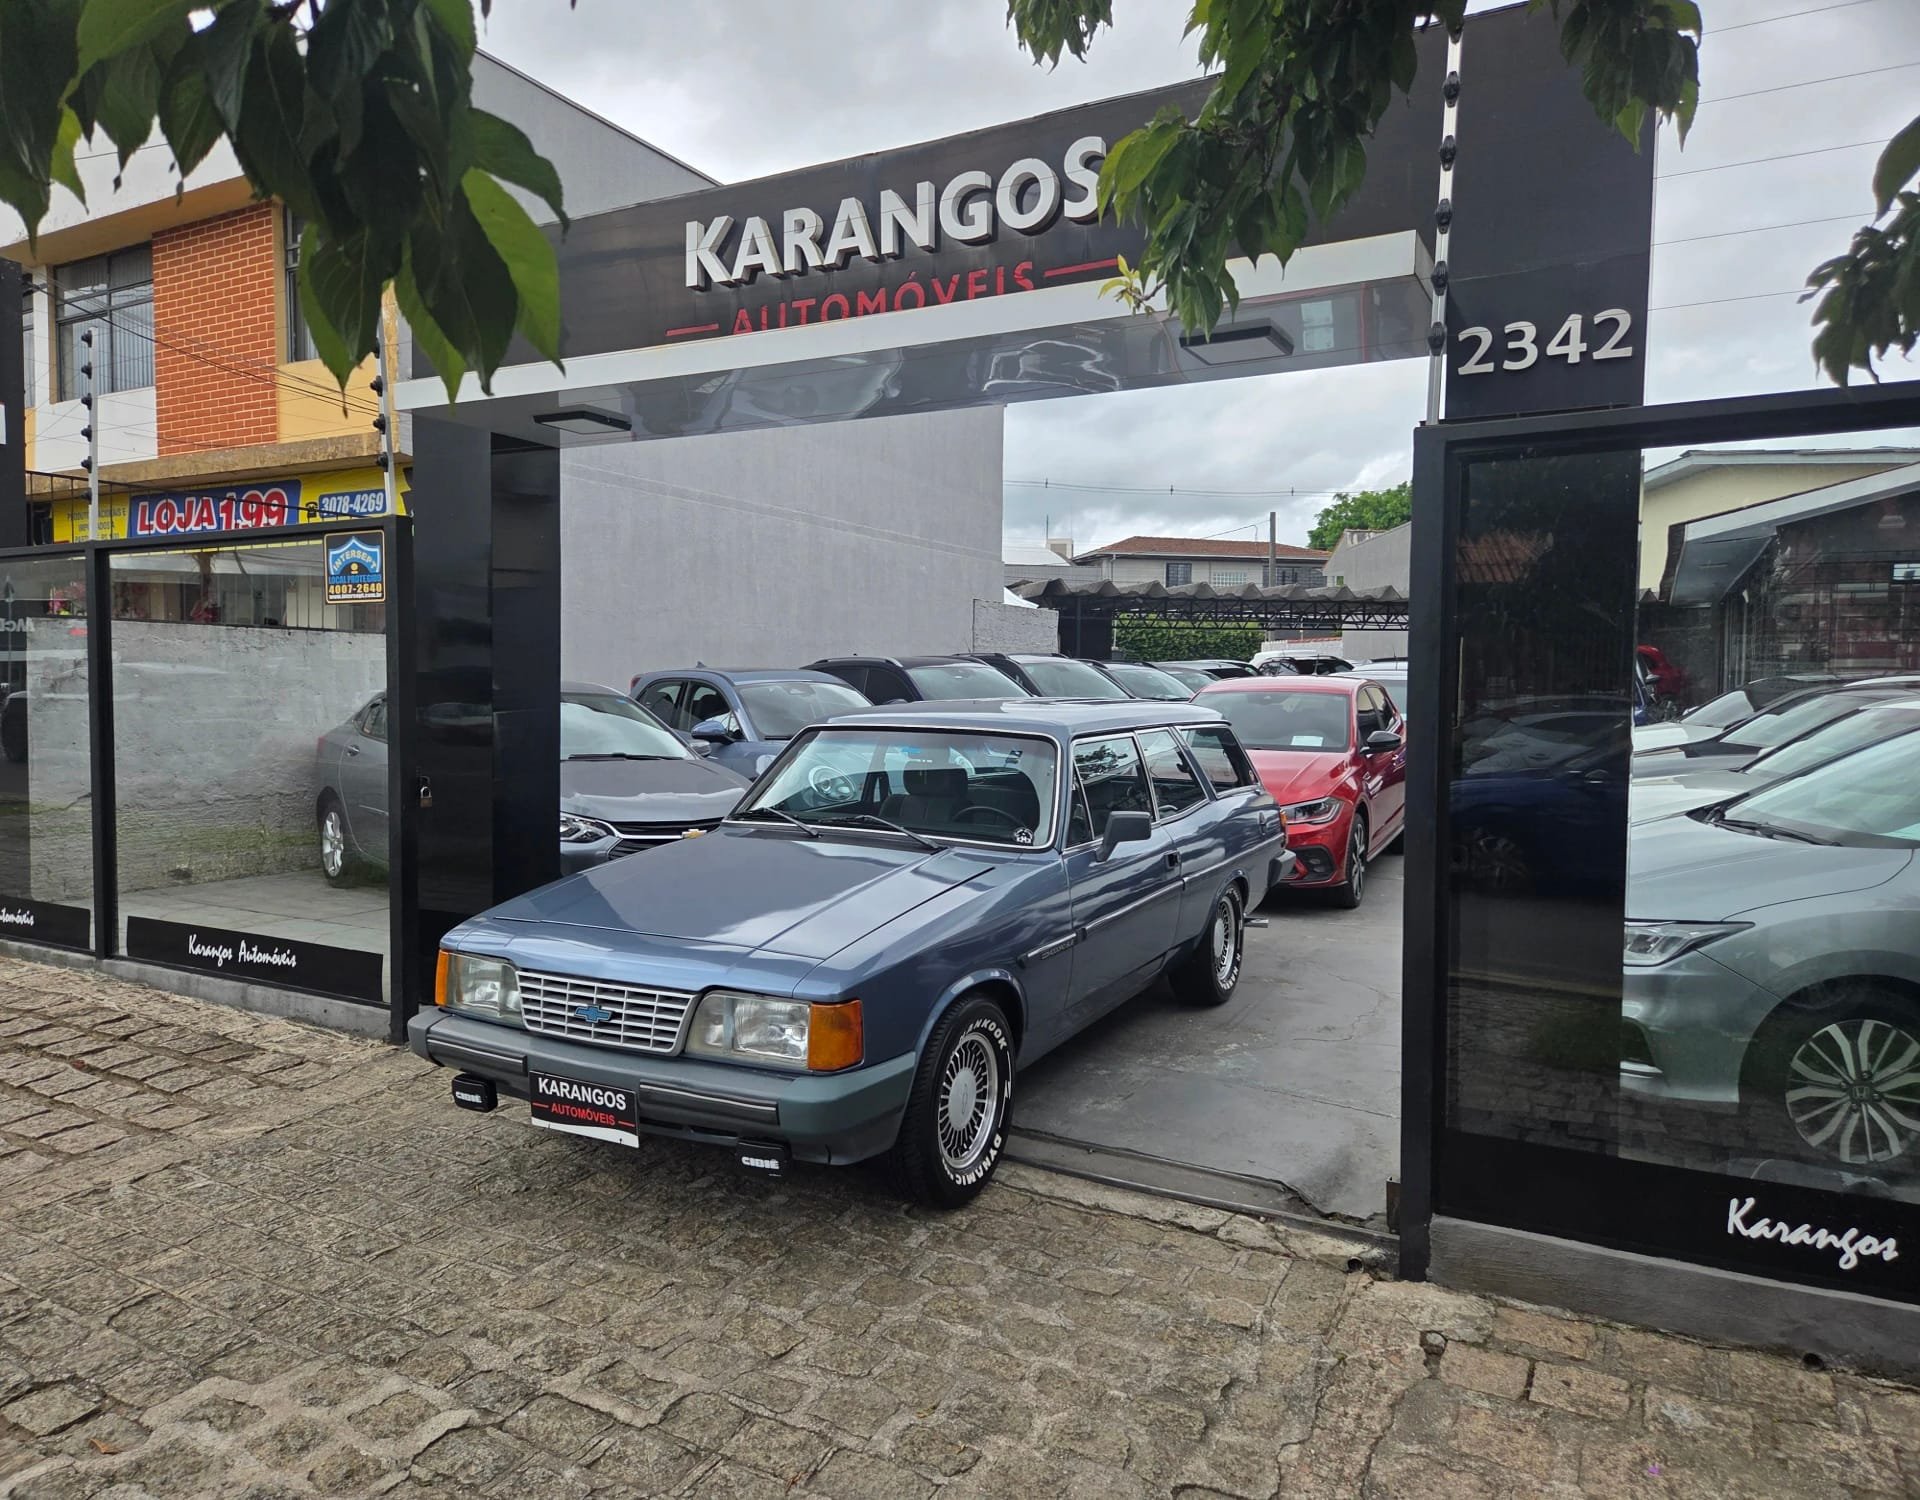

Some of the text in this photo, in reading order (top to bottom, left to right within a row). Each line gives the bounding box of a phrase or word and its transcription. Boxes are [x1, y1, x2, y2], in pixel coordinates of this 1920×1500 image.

[685, 136, 1107, 291] KARANGOS
[1457, 308, 1634, 376] 2342
[136, 496, 217, 535] LOJA
[321, 492, 384, 517] 3078-4269
[332, 549, 378, 571] INTERSEPT
[328, 583, 383, 595] 4007-2640
[188, 934, 297, 968] Karangos Automóveis
[537, 1077, 628, 1112] KARANGOS
[551, 1103, 616, 1126] AUTOMÓVEIS
[955, 1132, 1003, 1187] DYNAMIC
[1727, 1197, 1900, 1271] Karangos
